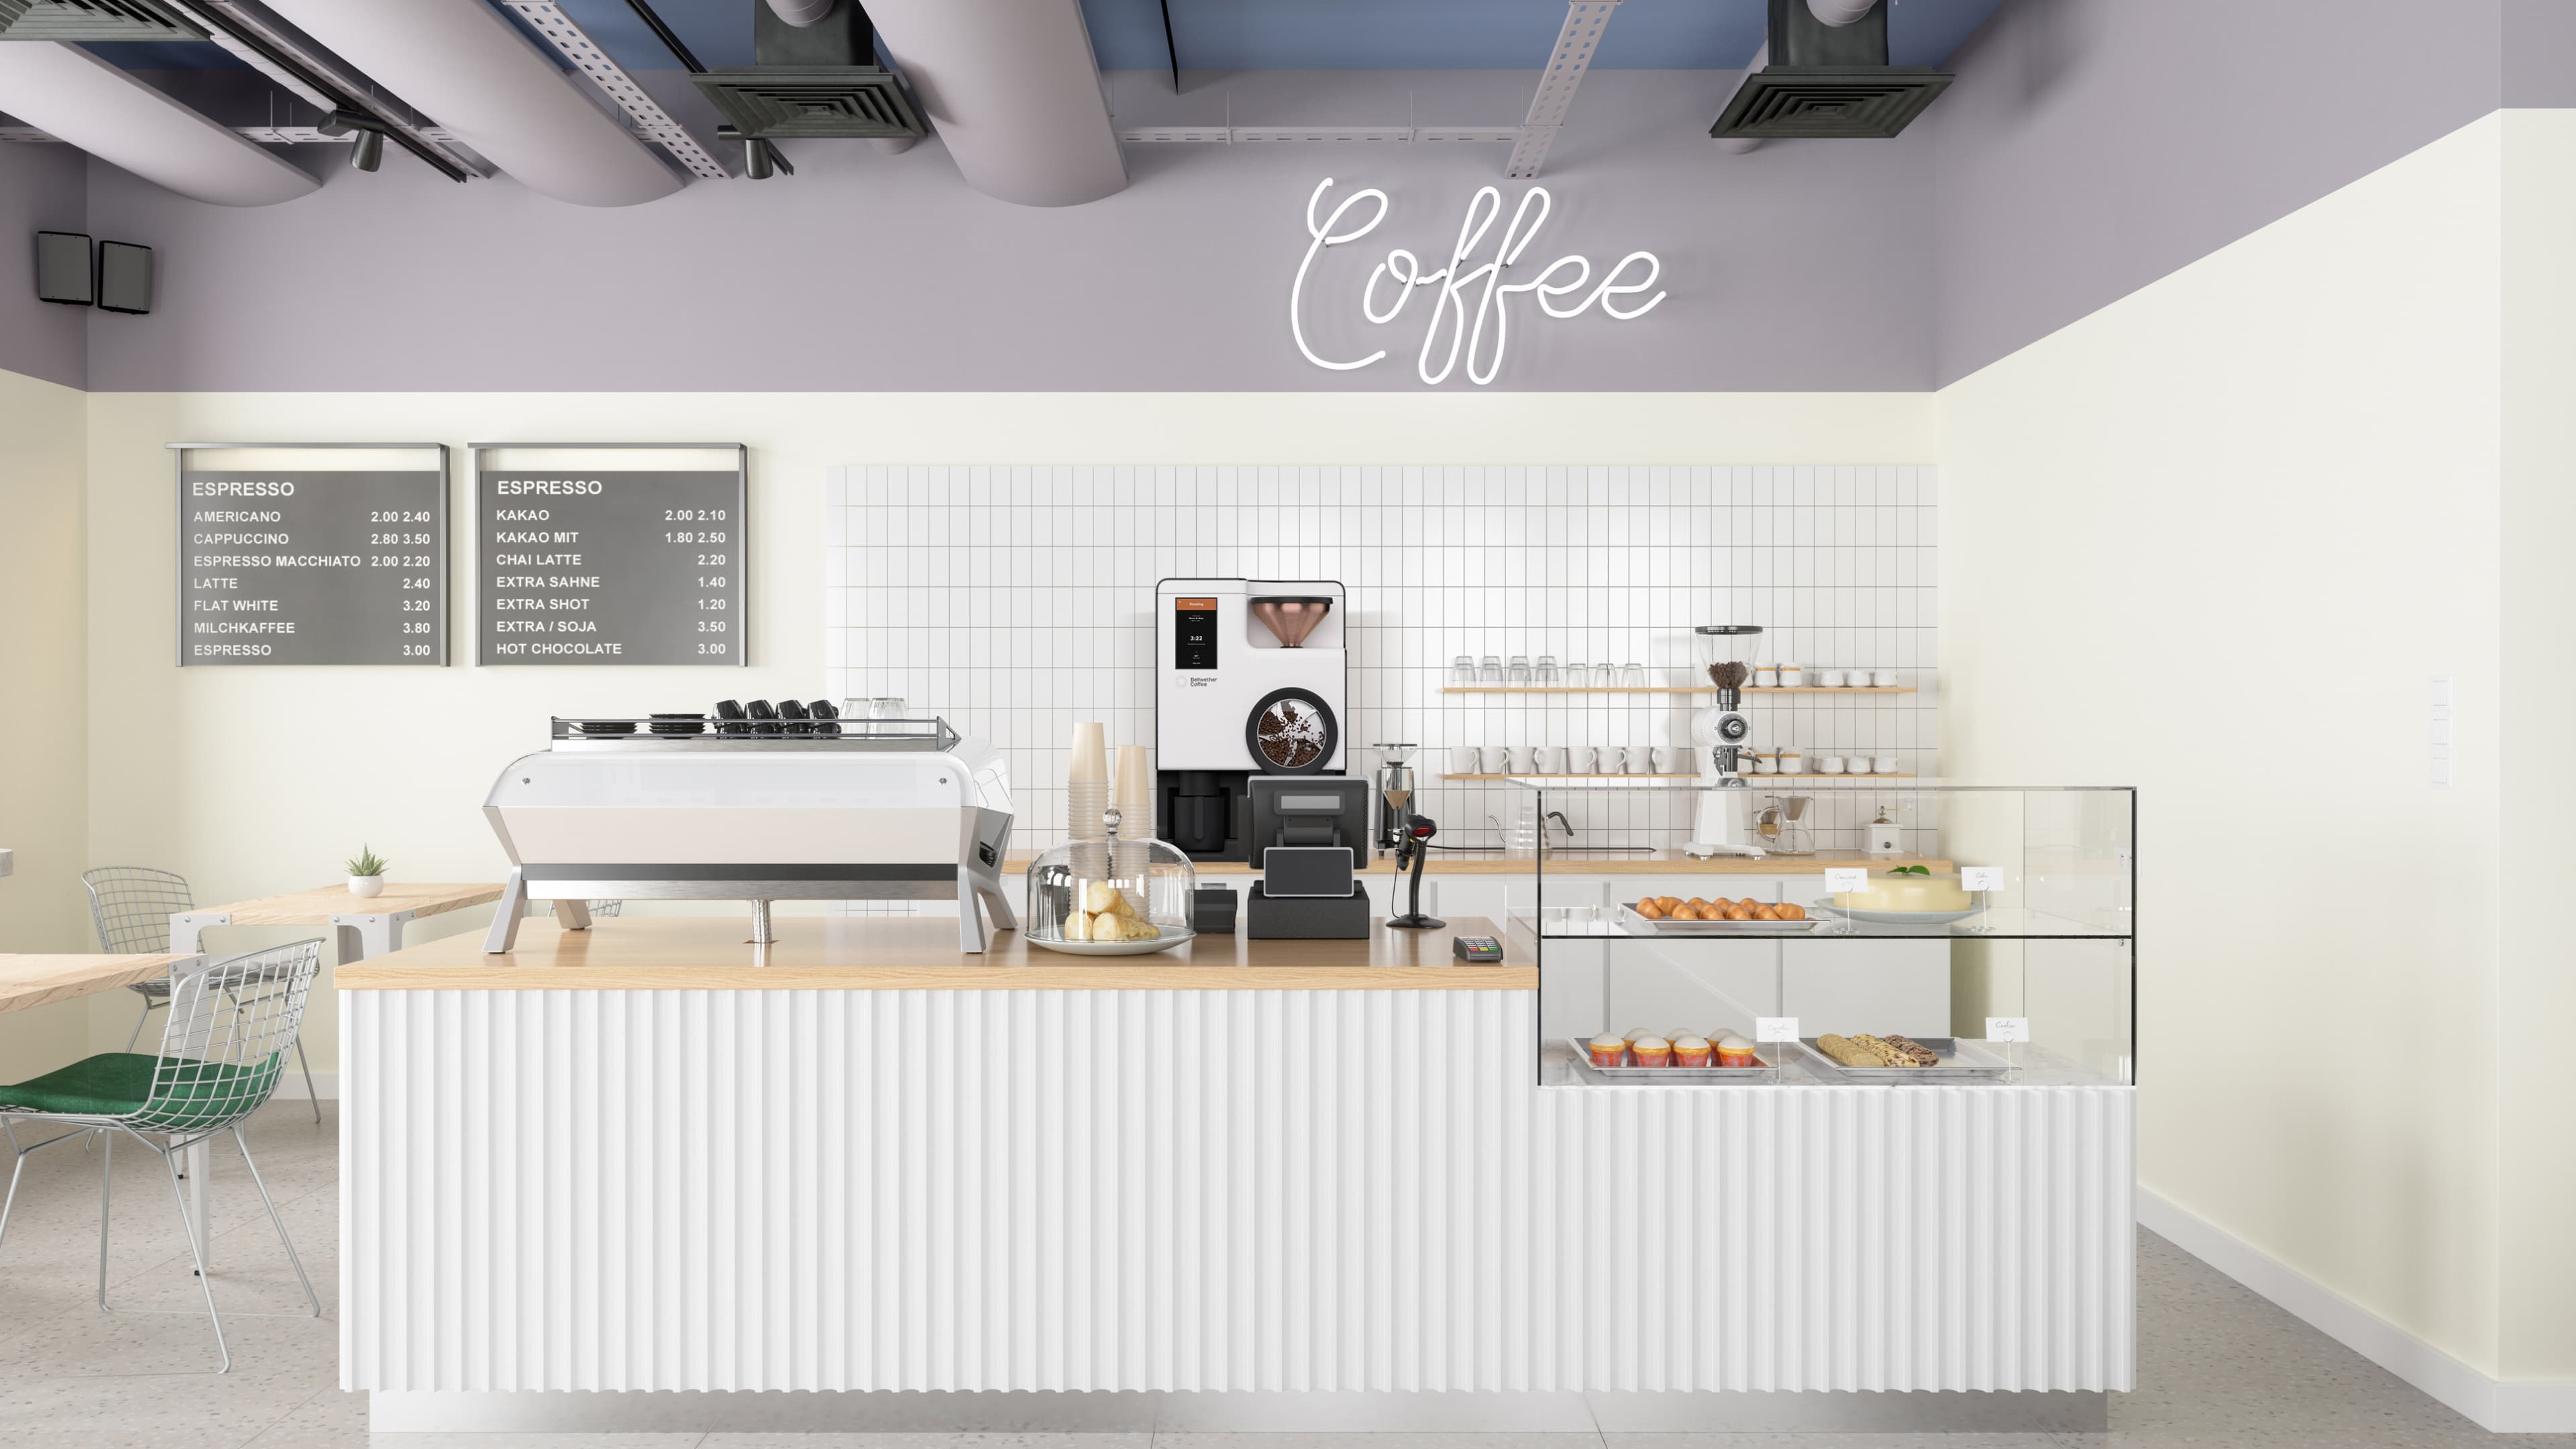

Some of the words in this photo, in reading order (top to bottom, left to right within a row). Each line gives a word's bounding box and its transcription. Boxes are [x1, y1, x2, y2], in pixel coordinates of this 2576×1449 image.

[1291, 177, 1669, 385] Coffee
[193, 482, 294, 496] ESPRESSO
[497, 480, 602, 495] ESPRESSO
[193, 511, 281, 523] AMERICANO
[371, 511, 398, 523] 2.00
[402, 511, 431, 523] 2.40
[496, 509, 550, 521] KAKAO
[665, 509, 693, 521] 2.00
[697, 509, 726, 521] 2.10
[194, 533, 289, 545] CAPPUCCINO
[371, 533, 398, 545] 2.80
[402, 533, 431, 545] 3.50
[496, 531, 550, 543] KAKAO
[553, 531, 580, 543] MIT
[665, 531, 693, 543] 1.80
[697, 532, 726, 543] 2.50
[194, 555, 272, 567] ESPRESSO
[276, 555, 361, 567] MACCHIATO
[371, 555, 398, 567] 2.00
[402, 555, 431, 567] 2.20
[496, 554, 532, 566] CHAI
[536, 554, 582, 566] LATTE
[697, 554, 726, 566] 2.20
[194, 578, 238, 589] LATTE
[402, 578, 431, 589] 2.40
[496, 576, 545, 588] EXTRA
[549, 576, 600, 588] SAHNE
[698, 576, 726, 588] 1.40
[194, 600, 229, 611] FLAT
[232, 600, 278, 611] WHITE
[402, 600, 431, 611] 3.20
[496, 598, 545, 610] EXTRA
[549, 598, 590, 610] SHOT
[698, 598, 726, 610] 1.20
[194, 622, 295, 634] MILCHKAFFEE
[403, 622, 431, 634] 3.80
[496, 621, 545, 632] EXTRA
[549, 621, 554, 632] /
[557, 621, 597, 633] SOJA
[698, 621, 726, 632] 3.50
[194, 644, 272, 656] ESPRESSO
[403, 644, 431, 656] 3.00
[496, 643, 527, 655] HOT
[531, 643, 622, 655] CHOCOLATE
[698, 643, 726, 655] 3.00
